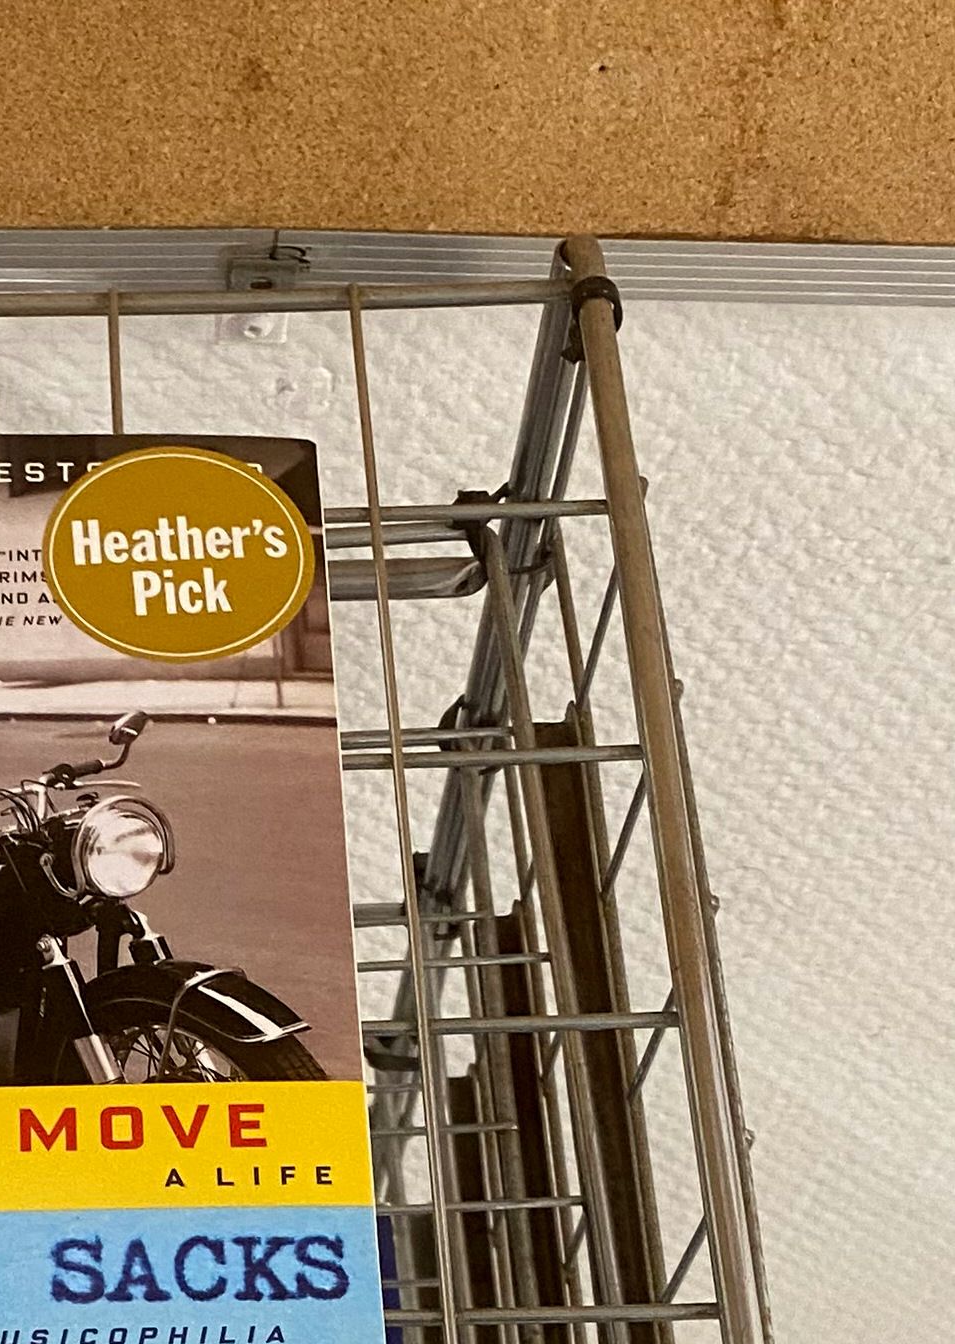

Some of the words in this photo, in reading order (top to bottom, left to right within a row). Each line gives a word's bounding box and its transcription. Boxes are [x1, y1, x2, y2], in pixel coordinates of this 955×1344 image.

[71, 515, 288, 566] Heather’s
[132, 567, 233, 616] Pick
[23, 615, 62, 626] NEW
[19, 1103, 268, 1153] MOVE
[164, 1167, 185, 1188] A
[216, 1165, 333, 1188] LIFE
[49, 1233, 351, 1306] SACKS
